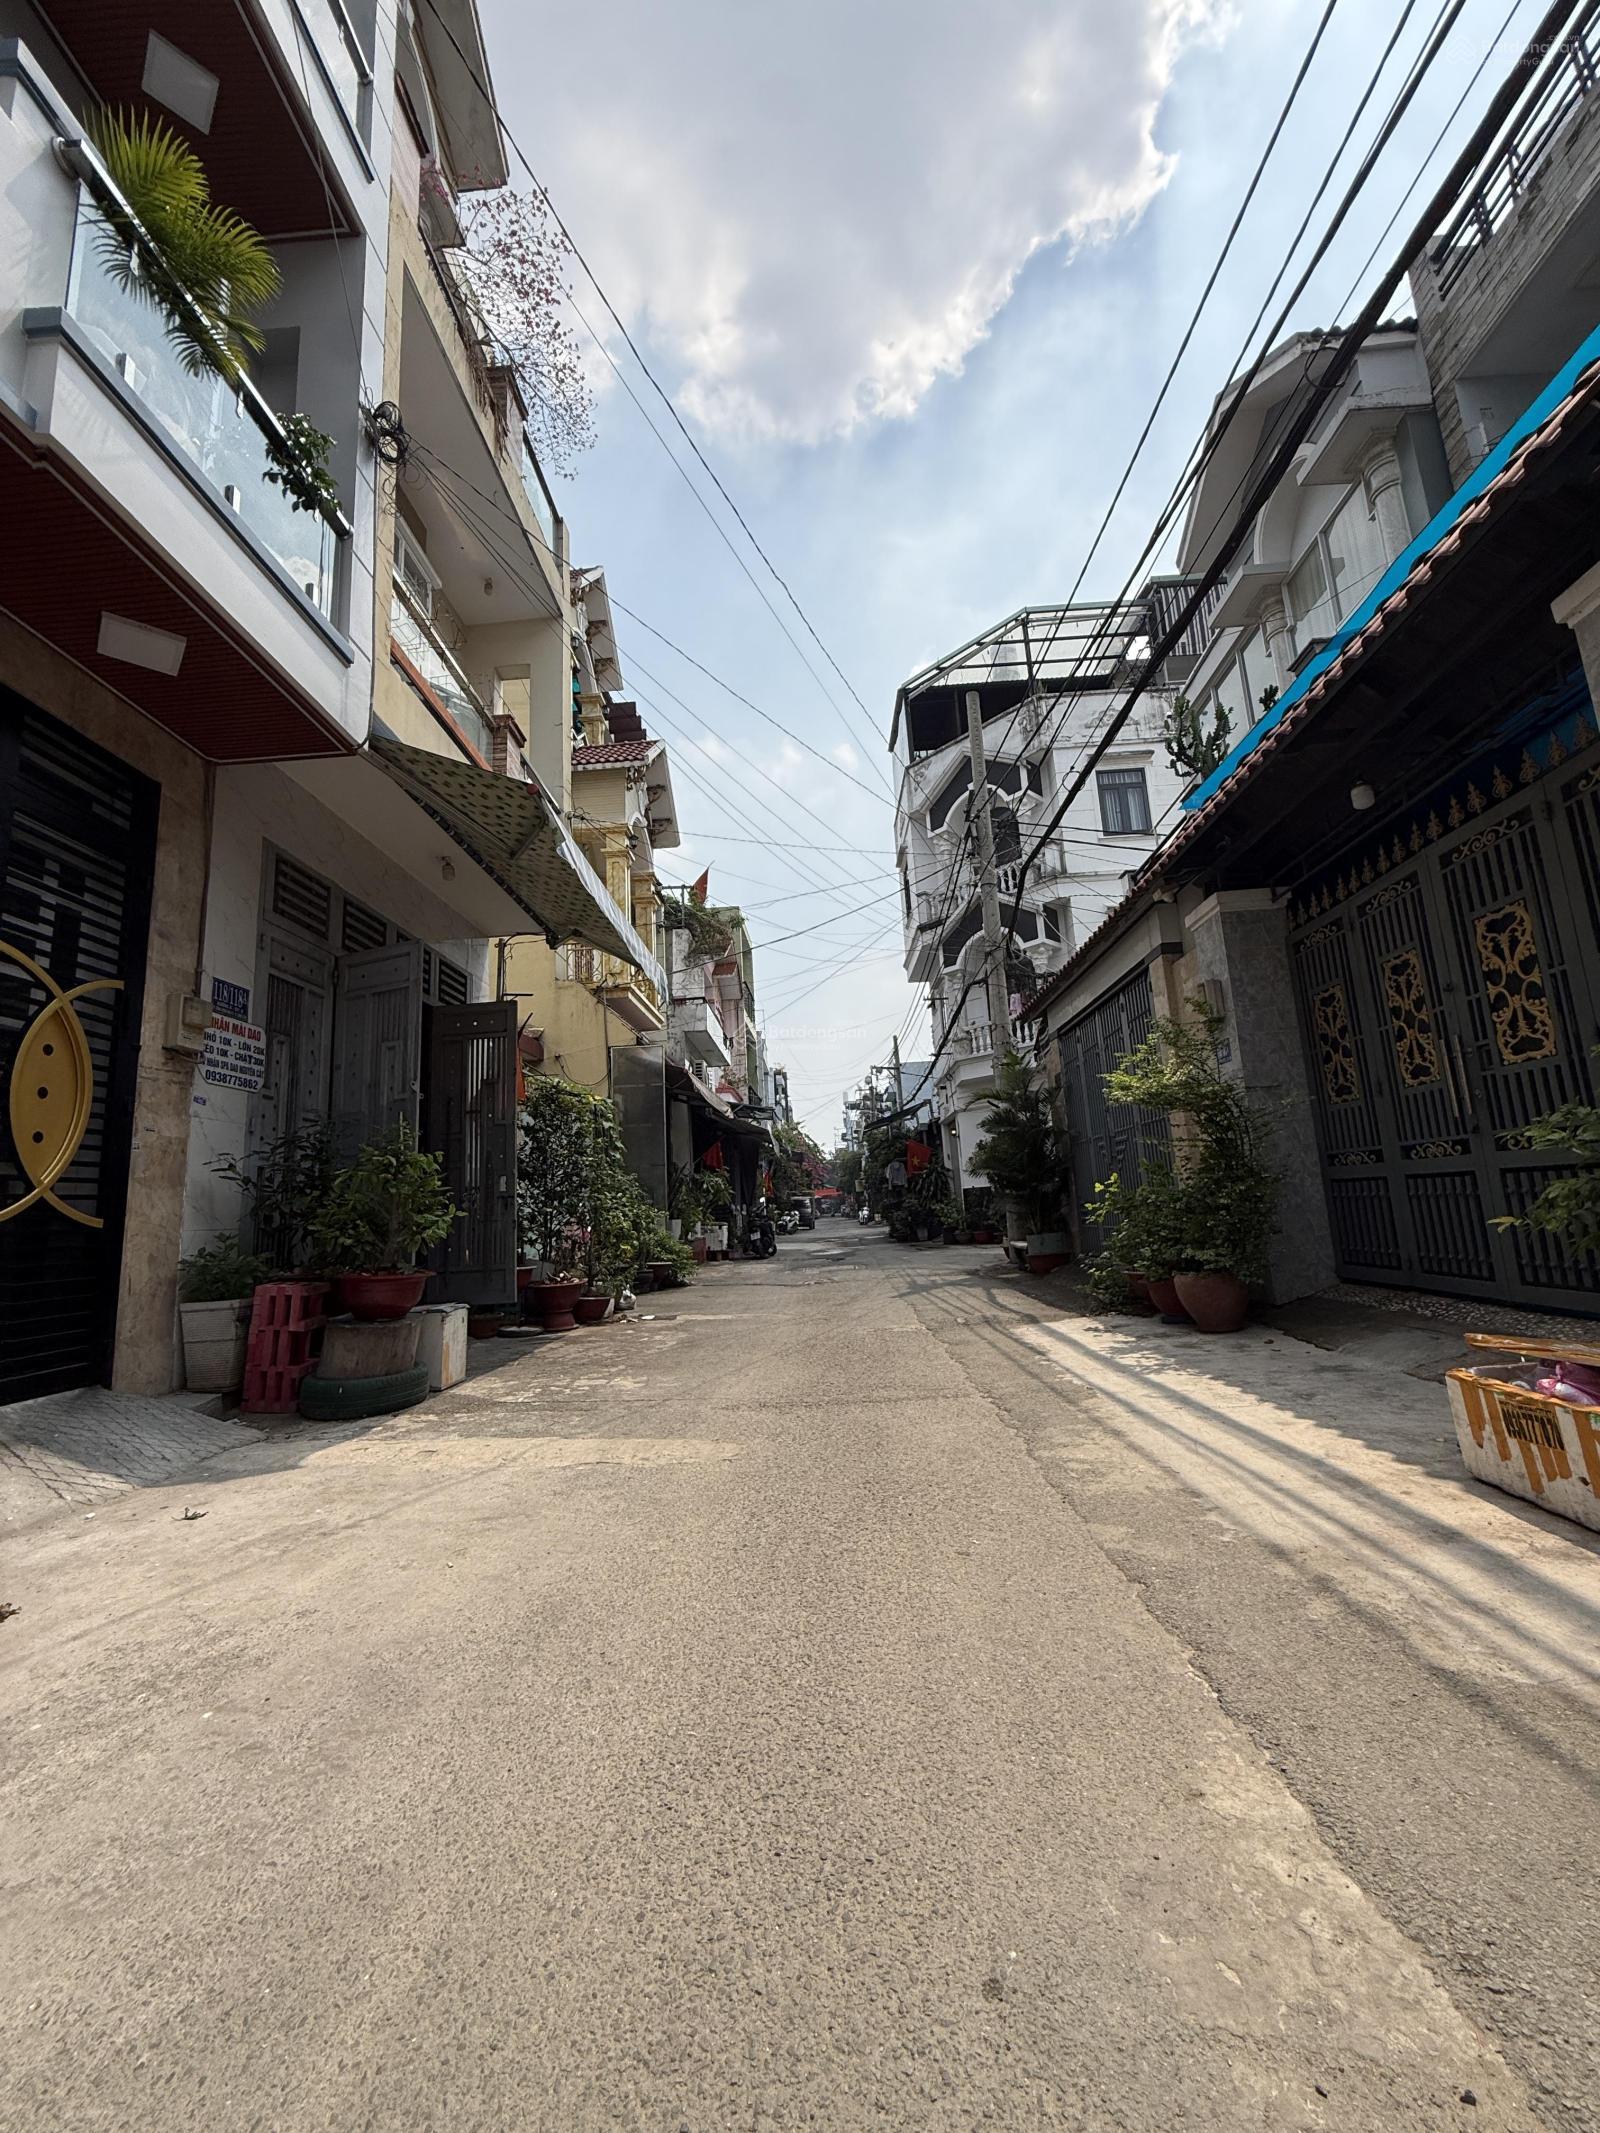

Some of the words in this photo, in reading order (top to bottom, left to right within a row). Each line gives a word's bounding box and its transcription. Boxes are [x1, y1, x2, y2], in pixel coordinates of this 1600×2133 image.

[247, 1027, 262, 1042] DAO
[203, 1043, 215, 1055] ÉO
[216, 1047, 229, 1058] 10K
[218, 1035, 232, 1047] 10K
[252, 1045, 265, 1056] 20K
[205, 1069, 259, 1090] 0938775862
